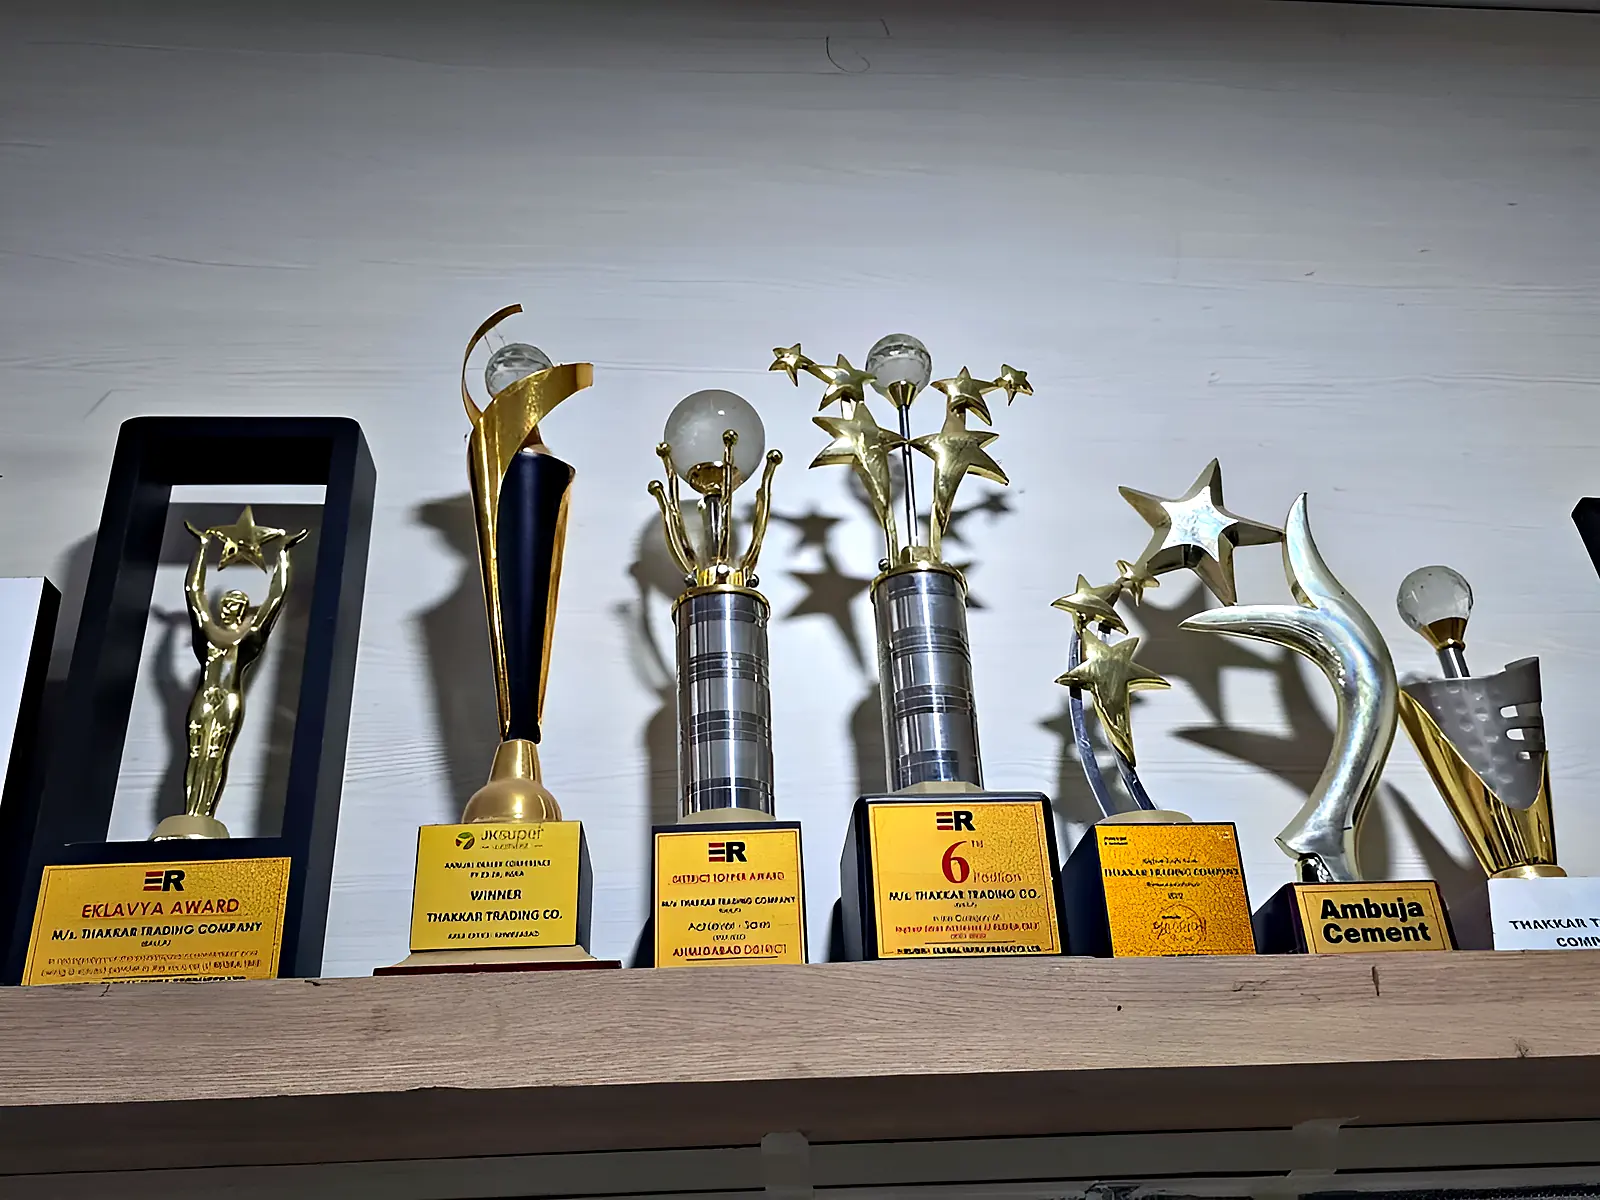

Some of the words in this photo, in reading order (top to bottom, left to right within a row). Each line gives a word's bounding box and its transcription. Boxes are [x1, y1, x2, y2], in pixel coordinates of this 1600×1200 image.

[936, 811, 976, 831] ER
[708, 842, 747, 862] ER
[942, 840, 970, 884] 6
[143, 869, 186, 891] ER
[750, 872, 784, 881] AWARD
[470, 889, 521, 900] WINNER
[680, 899, 715, 907] THAKKAR
[718, 897, 752, 905] TRADING
[755, 896, 795, 904] COMPANY
[915, 890, 964, 900] THAKKAR
[967, 889, 1015, 899] TRADING
[1019, 889, 1041, 899] CO.
[81, 901, 164, 918] EKLAVYA
[170, 898, 240, 915] AWARD
[427, 911, 482, 922] THAKKAR
[486, 910, 539, 921] TRADING
[543, 909, 562, 919] CO.
[1321, 897, 1424, 922] Ambuja
[81, 927, 138, 939] THAKKAR
[141, 924, 194, 936] TRADING
[198, 921, 263, 935] COMPANY
[1323, 922, 1431, 943] Cement
[1509, 918, 1587, 930] THAKKAR
